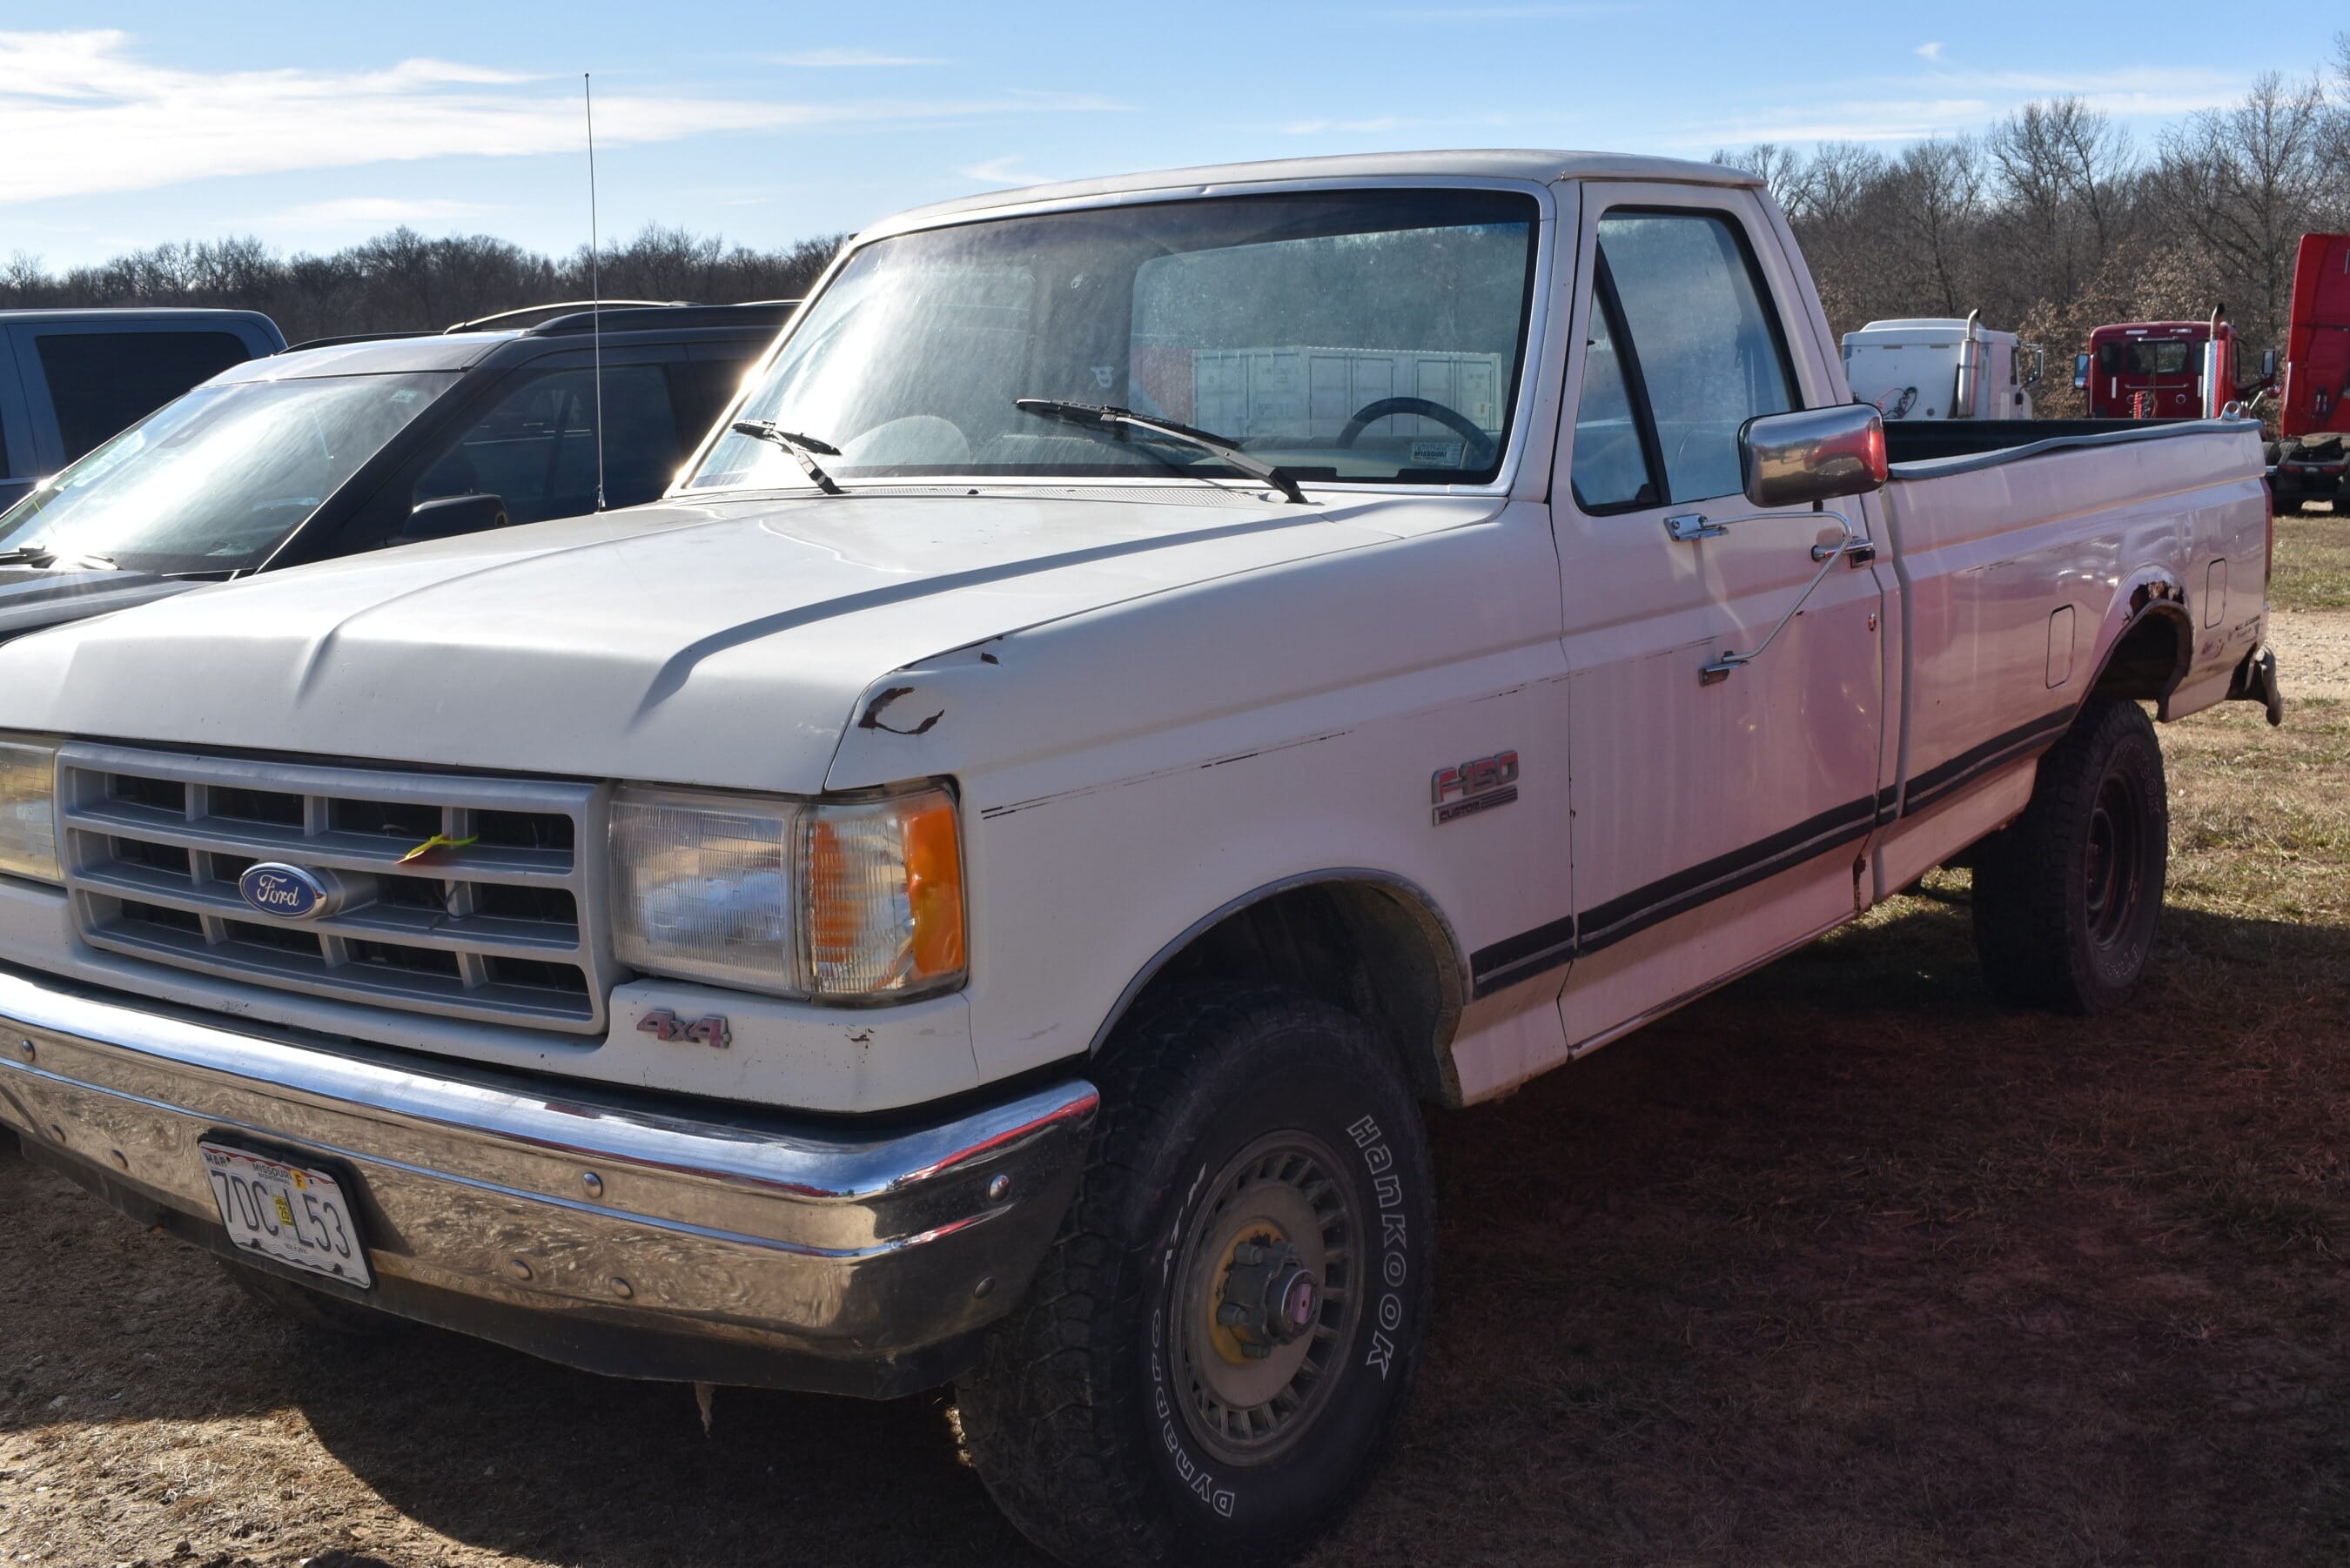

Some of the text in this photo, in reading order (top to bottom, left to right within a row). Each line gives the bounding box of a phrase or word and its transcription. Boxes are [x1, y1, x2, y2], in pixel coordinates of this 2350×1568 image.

[257, 874, 299, 907] Ford
[205, 1153, 227, 1167] MAR
[211, 1169, 351, 1259] 7DC L53
